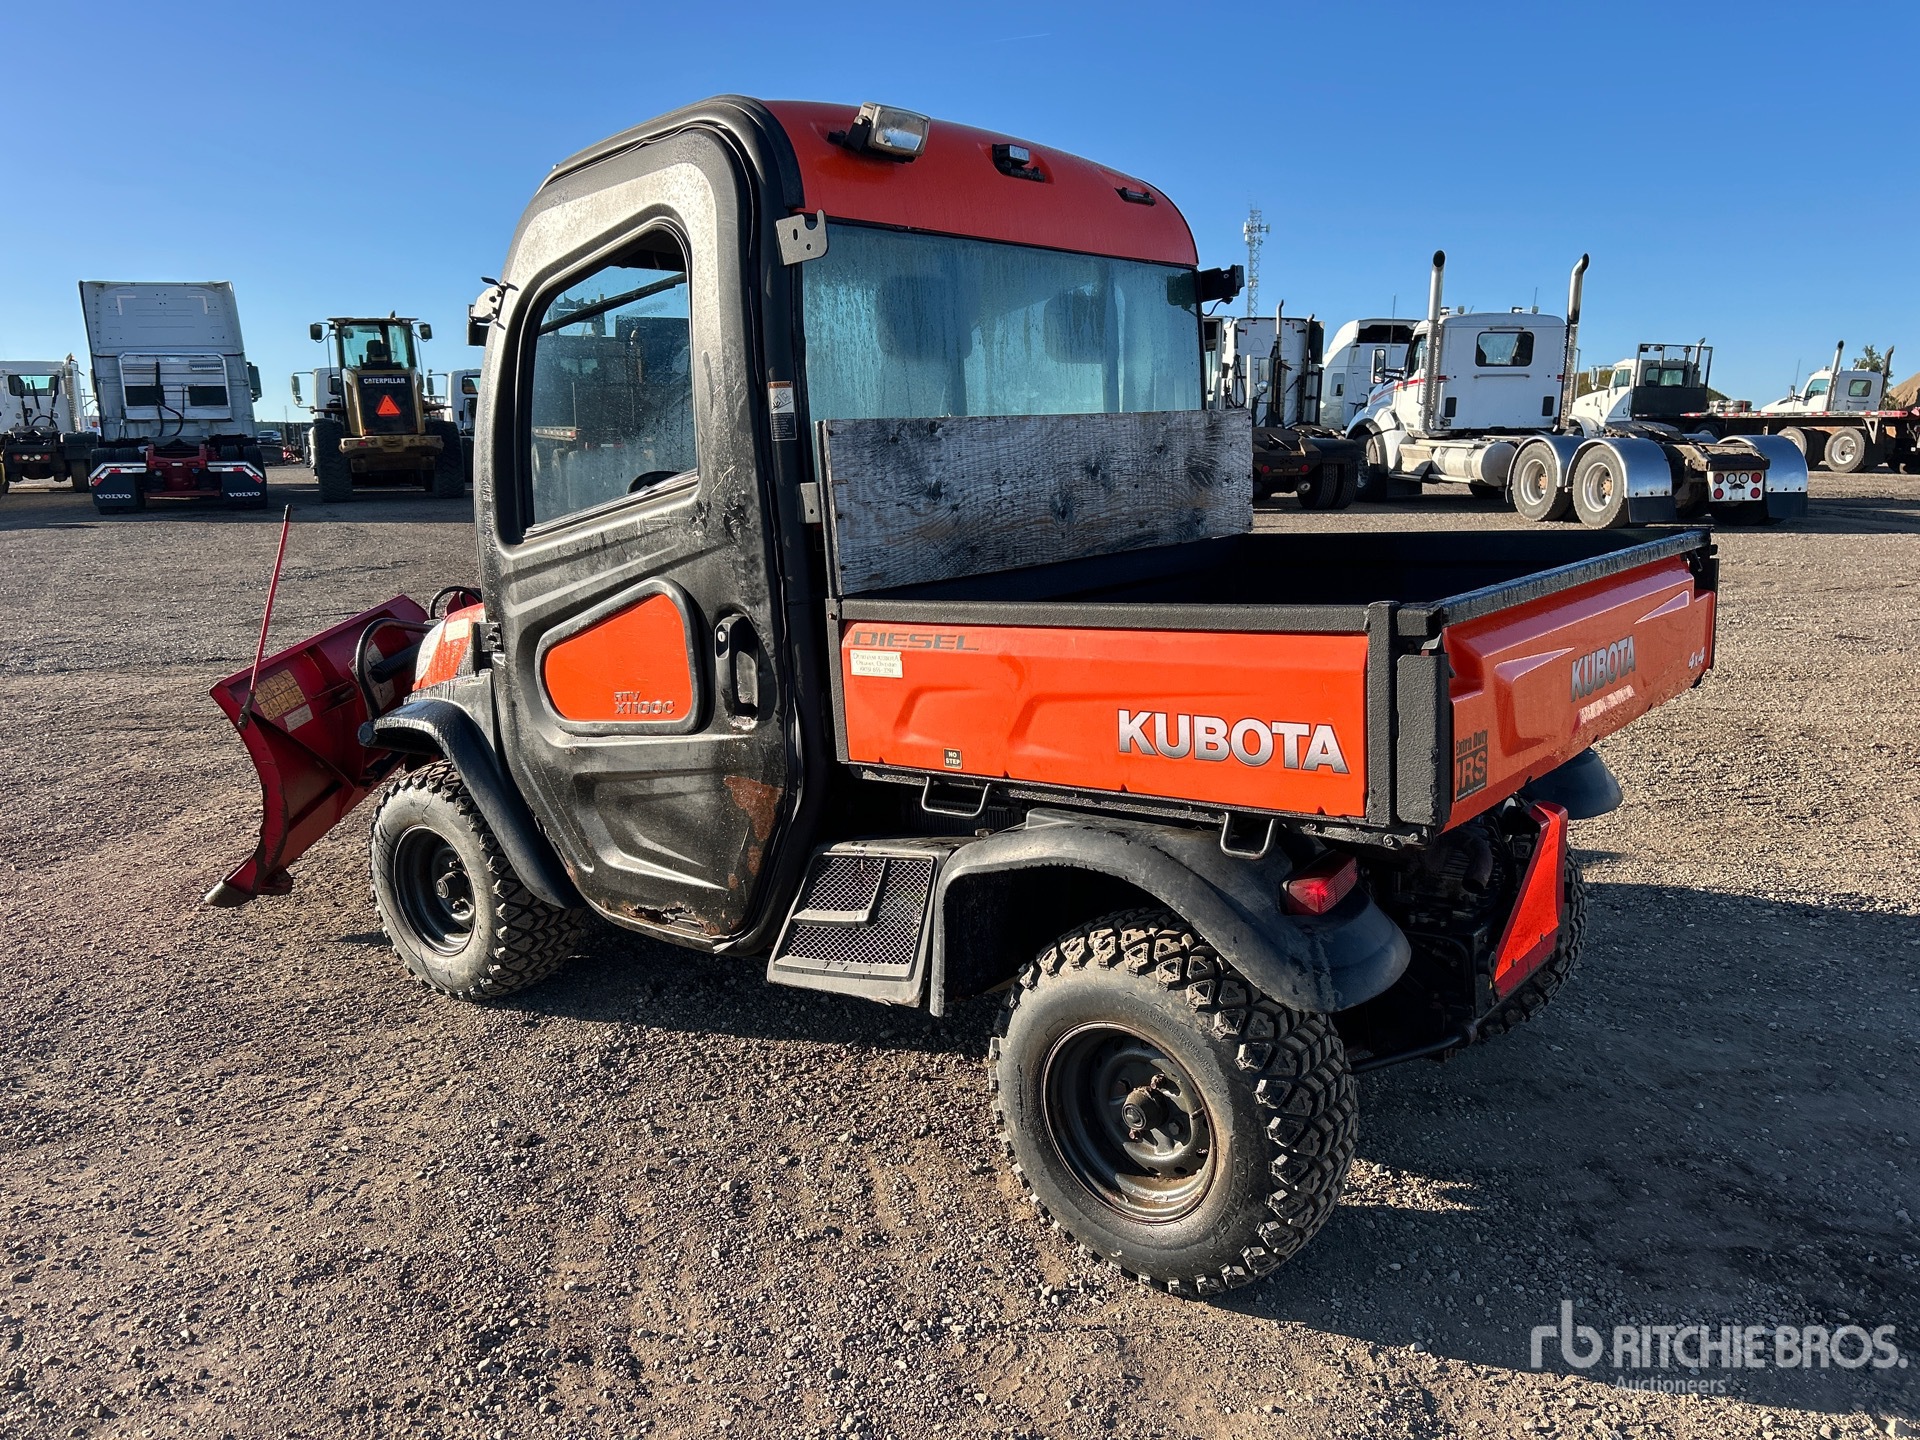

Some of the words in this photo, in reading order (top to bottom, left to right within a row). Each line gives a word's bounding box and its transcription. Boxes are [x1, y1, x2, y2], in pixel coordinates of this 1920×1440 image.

[853, 631, 980, 651] DIESEL
[1571, 634, 1636, 703] KUBOTA
[614, 691, 641, 702] RTV
[615, 701, 675, 715] X1100C
[1117, 709, 1350, 775] KUBOTA
[945, 757, 960, 765] STEP
[1456, 751, 1487, 791] IRS
